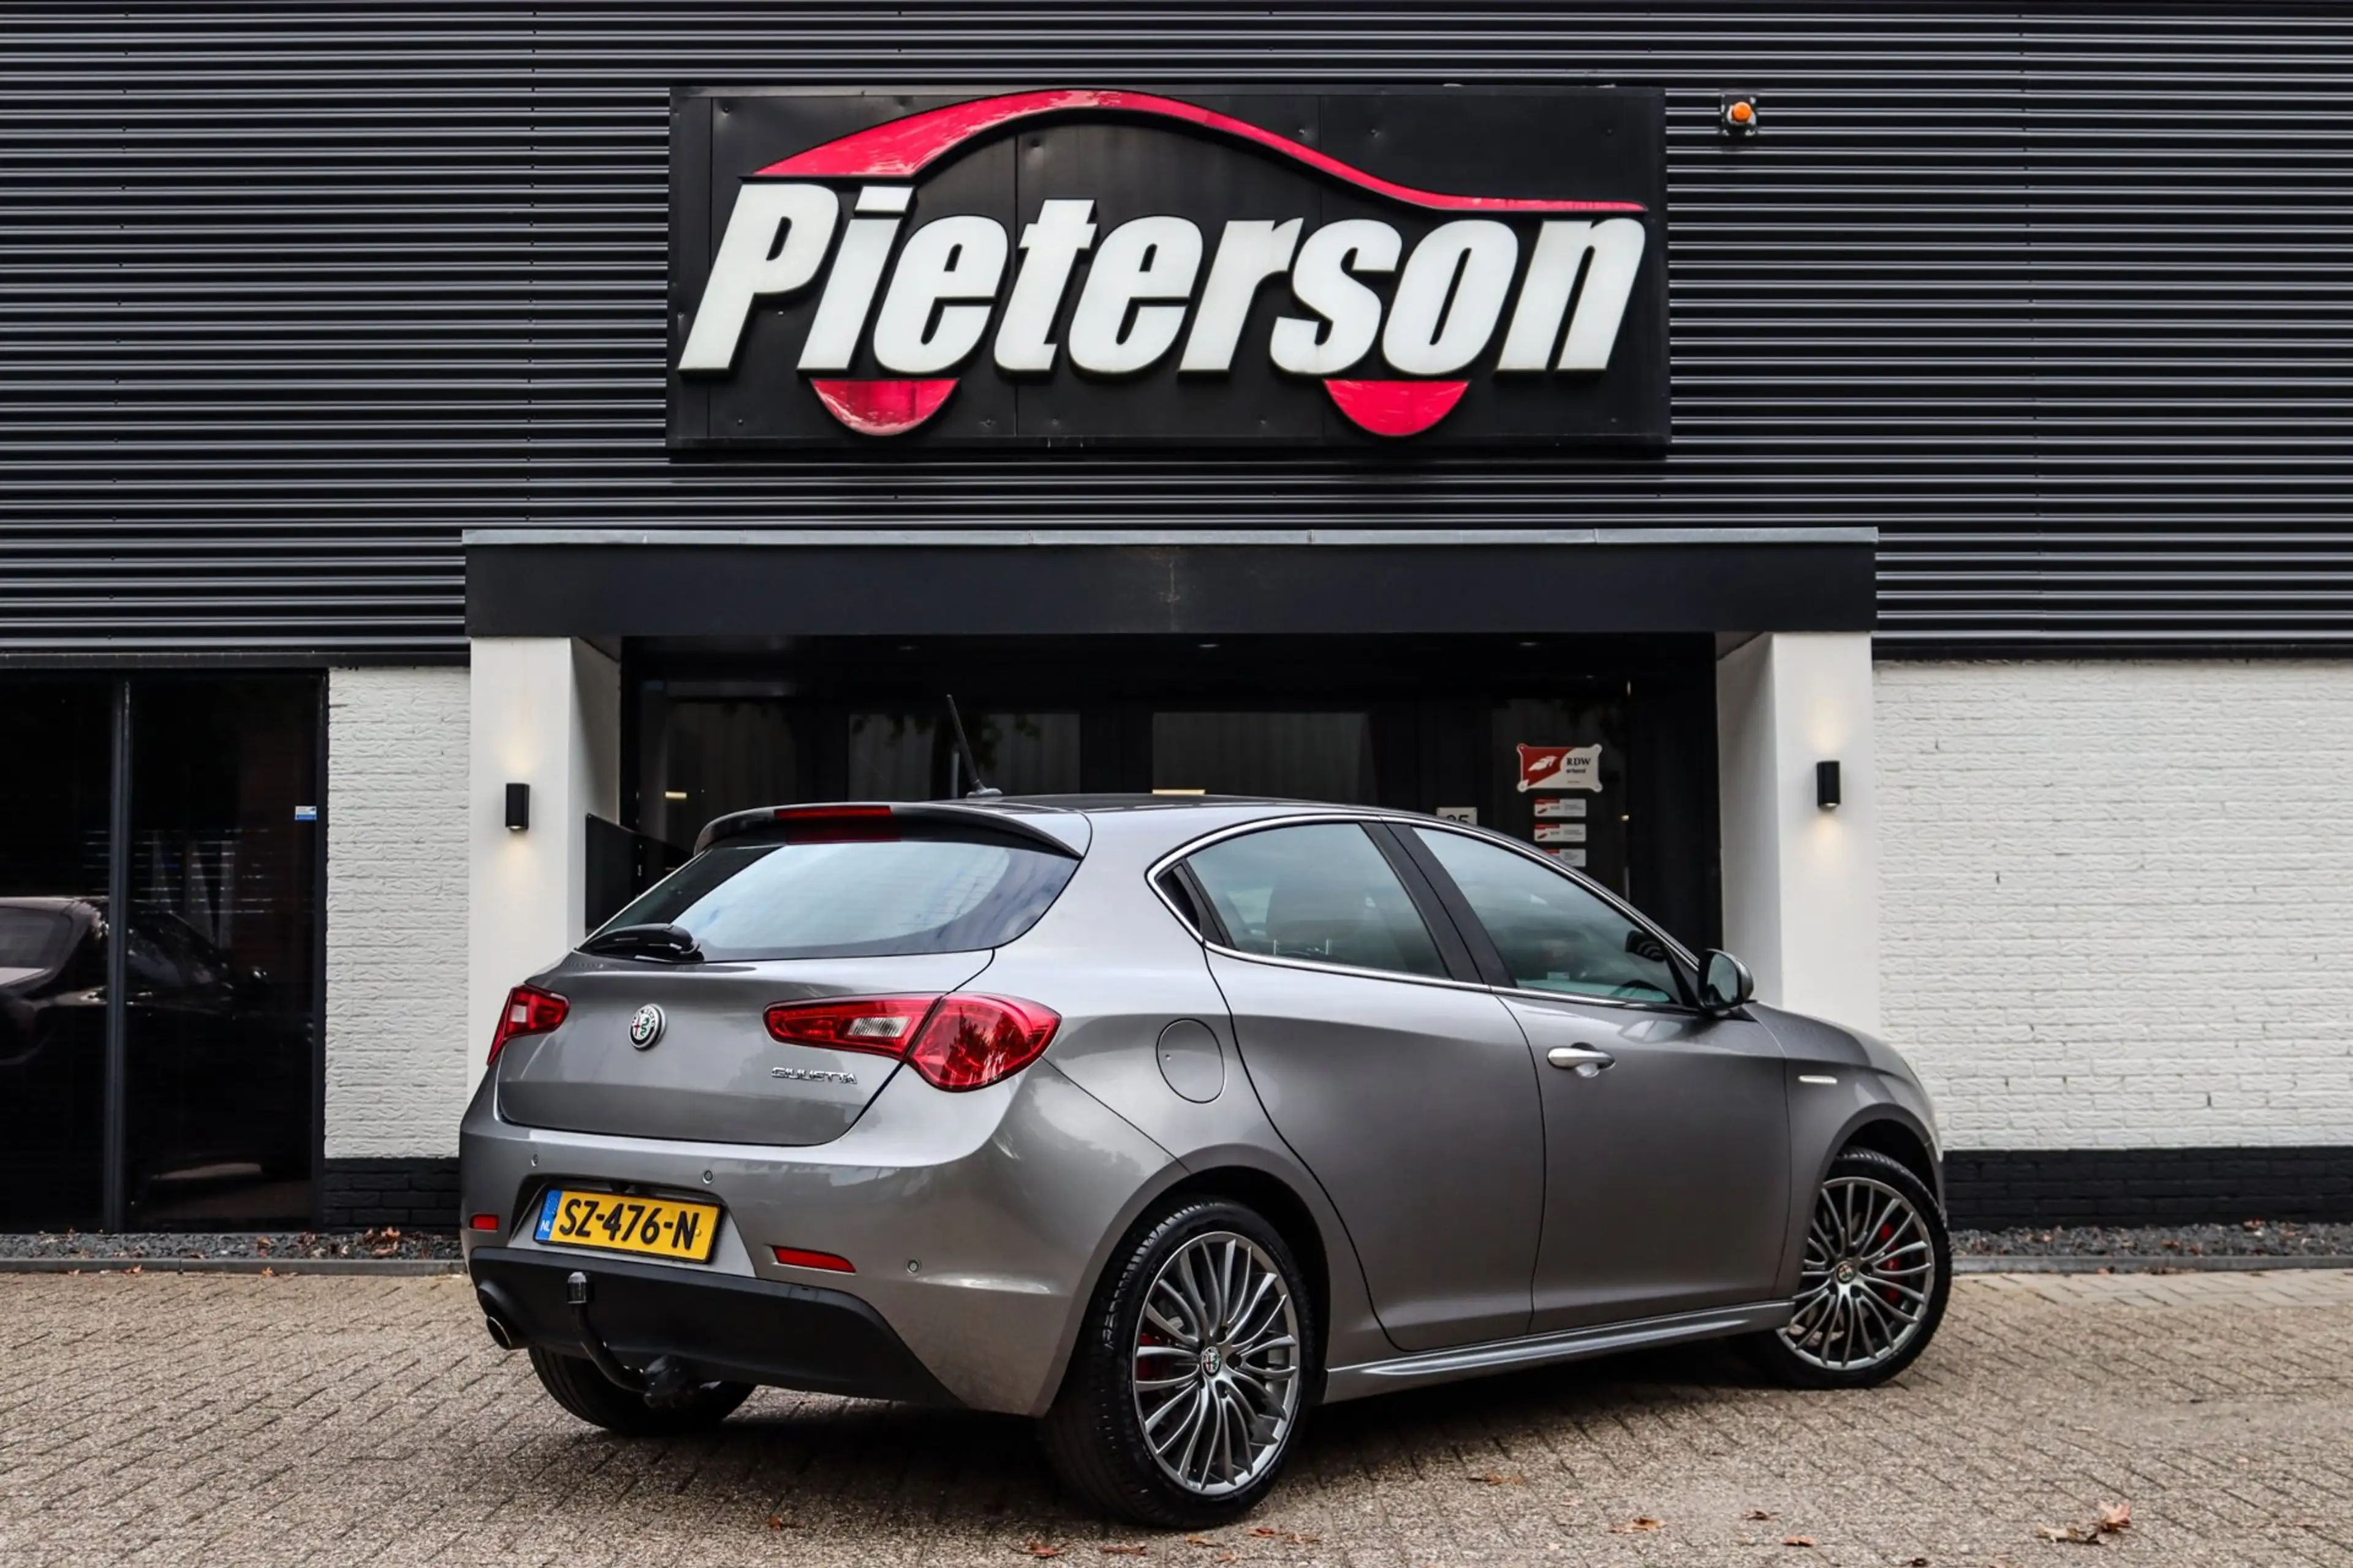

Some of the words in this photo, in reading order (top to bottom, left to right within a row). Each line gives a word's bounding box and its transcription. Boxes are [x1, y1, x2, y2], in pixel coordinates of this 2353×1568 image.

[677, 183, 1646, 375] Pieterson
[1566, 757, 1591, 766] RDW
[539, 1220, 550, 1232] NL
[559, 1199, 700, 1250] SZ-476-N
